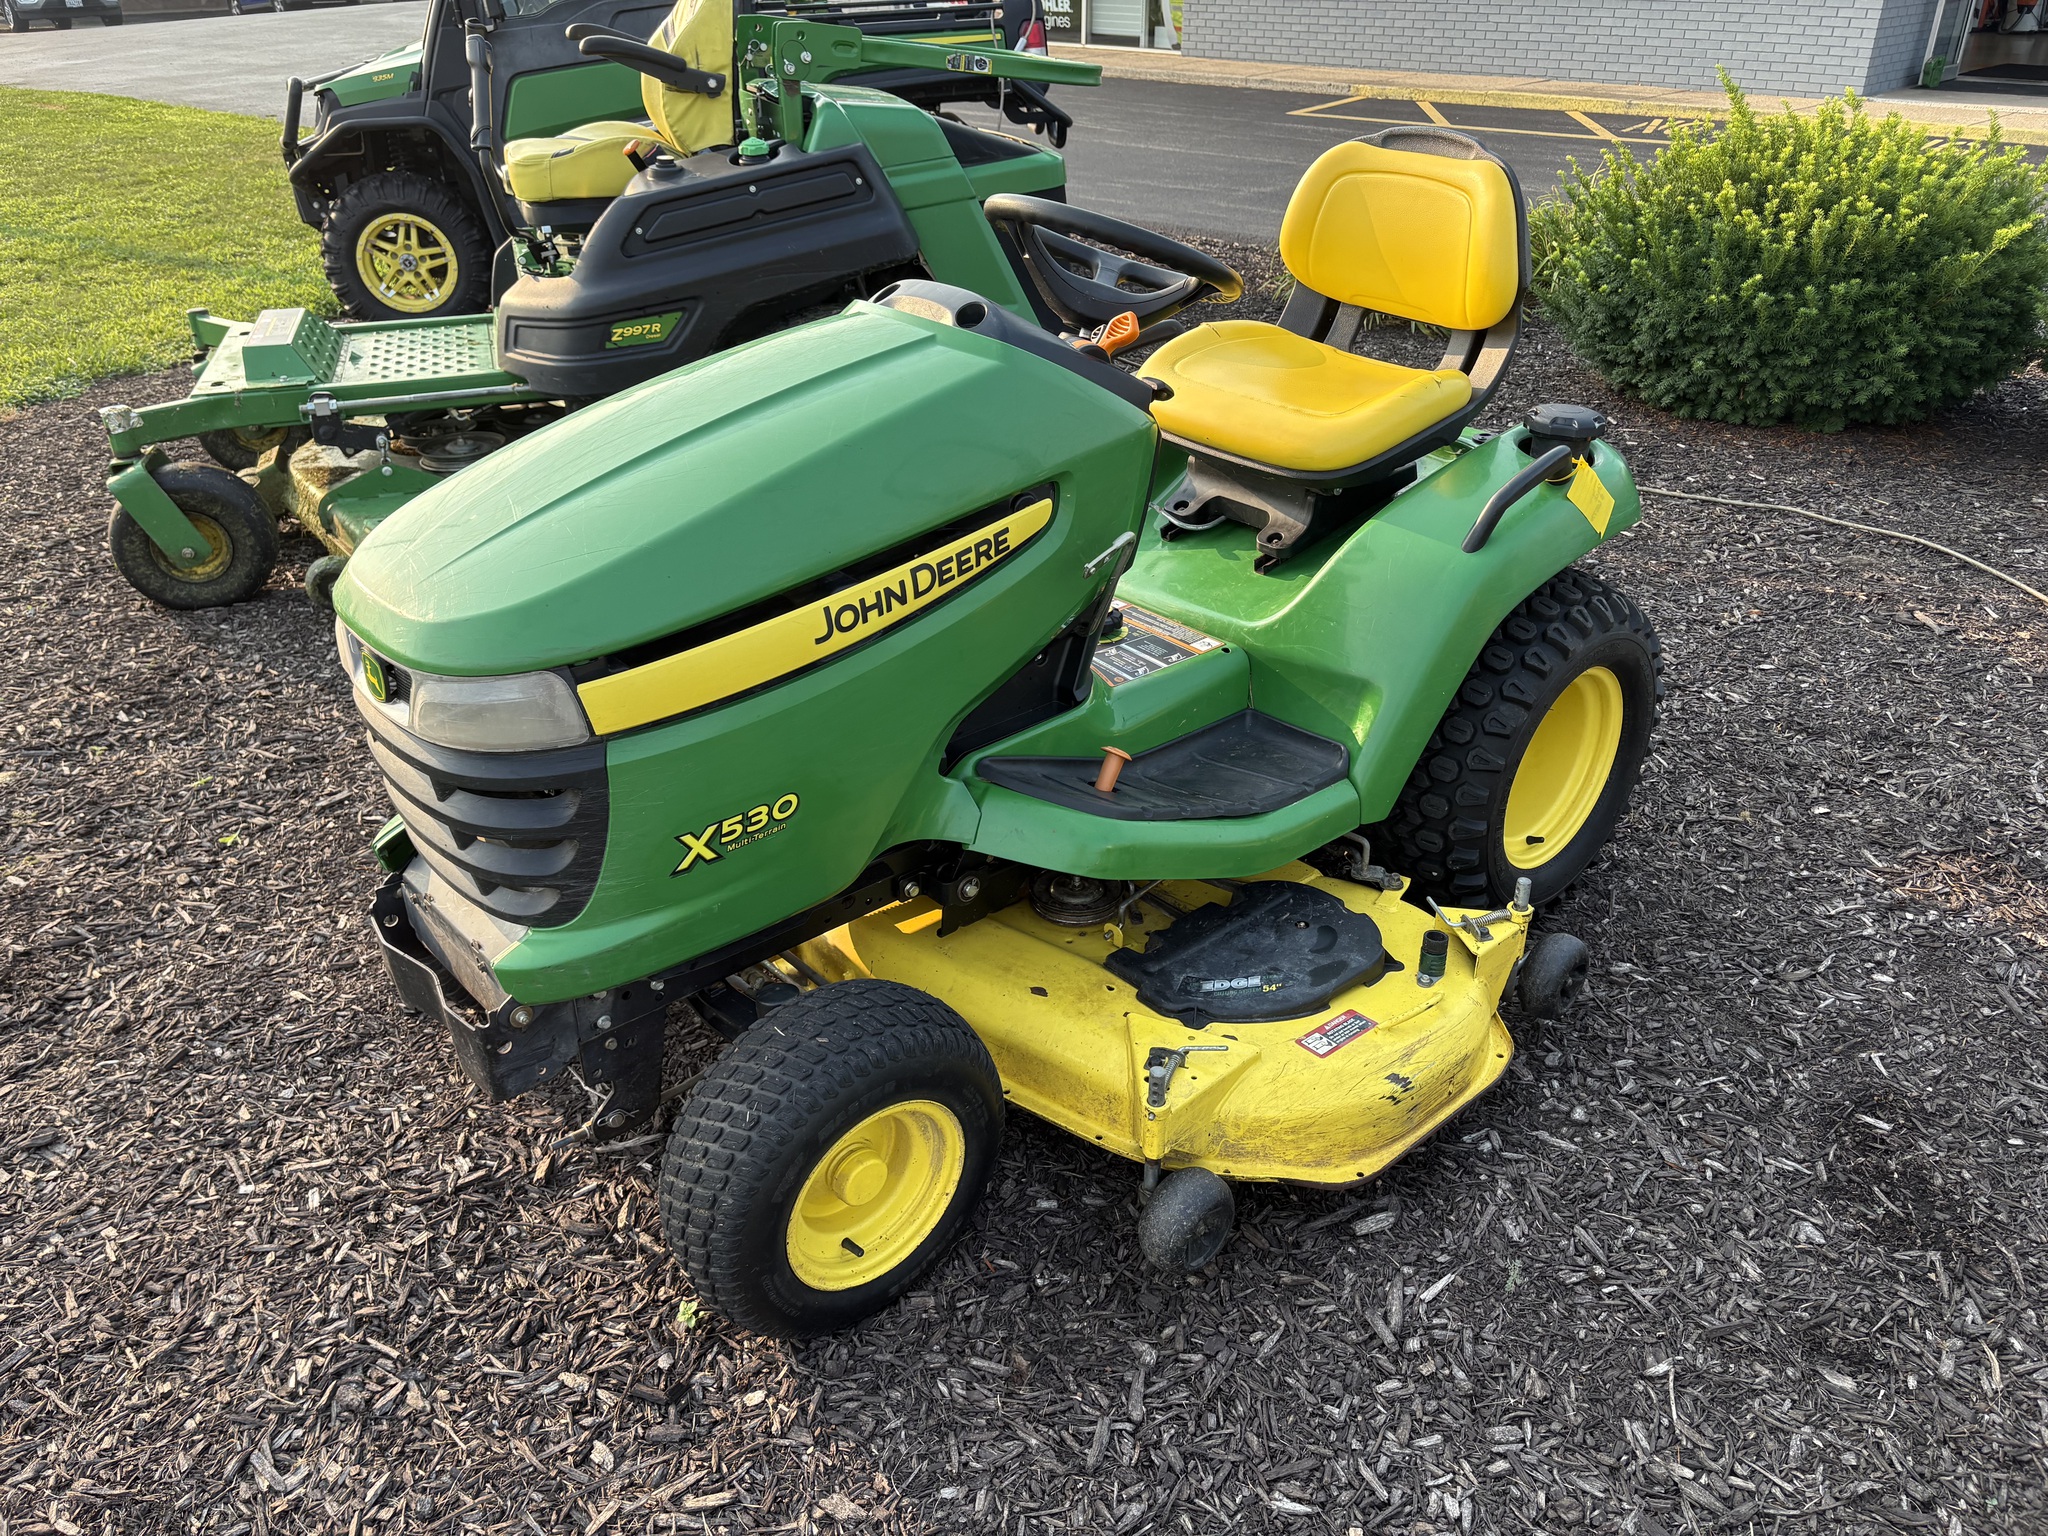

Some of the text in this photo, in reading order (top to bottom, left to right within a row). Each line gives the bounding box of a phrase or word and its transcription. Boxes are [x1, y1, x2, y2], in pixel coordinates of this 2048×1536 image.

[1044, 12, 1071, 30] gines
[372, 73, 394, 82] 935M
[611, 323, 662, 342] Z997R
[814, 527, 1011, 645] JOHN DEERE
[670, 792, 800, 877] X530
[727, 822, 787, 852] Multi-Terrain
[1200, 976, 1261, 992] EDGE
